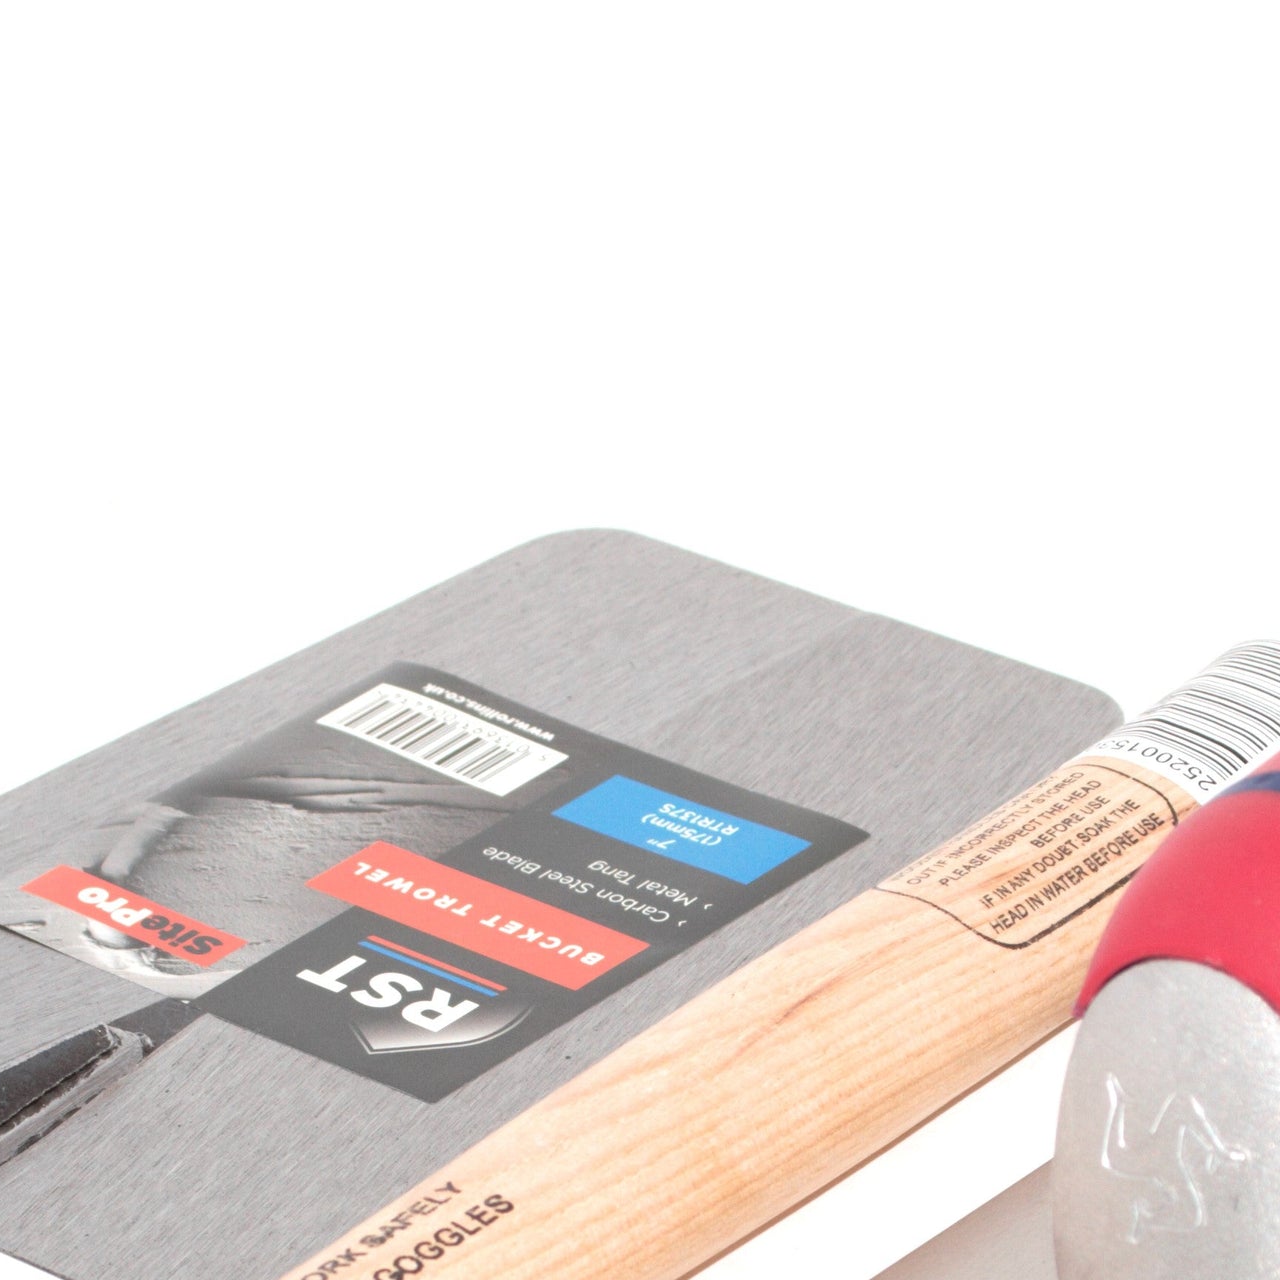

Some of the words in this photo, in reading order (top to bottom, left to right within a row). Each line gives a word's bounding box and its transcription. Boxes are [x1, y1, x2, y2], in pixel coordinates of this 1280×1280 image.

[422, 682, 556, 742] www.rollins.co.uk
[640, 812, 723, 848] (175mm)
[937, 852, 992, 887] PLEASE
[988, 818, 1044, 856] INSPECT
[1039, 800, 1067, 823] THE
[1063, 779, 1102, 812] HEAD
[1030, 812, 1083, 849] BEFORE
[1082, 795, 1112, 820] USE
[481, 845, 540, 876] Blade
[586, 859, 638, 887] Tang
[906, 865, 937, 886] OUT
[978, 889, 996, 909] IF
[990, 882, 1011, 902] IN
[1006, 867, 1036, 896] ANY
[1110, 797, 1142, 825] THE
[989, 903, 1030, 935] HEAD
[1024, 891, 1046, 911] IN
[1041, 864, 1090, 904] WATER
[1083, 831, 1141, 875] BEFORE
[1130, 811, 1166, 840] USE
[352, 860, 475, 918] TROWEL
[538, 868, 596, 896] Steel
[596, 887, 672, 926] Carbon
[636, 877, 699, 908] Metal
[77, 886, 225, 957] SitePro
[479, 911, 606, 968] BUCKET
[295, 954, 480, 1034] RST
[357, 1179, 463, 1249] SAFELY
